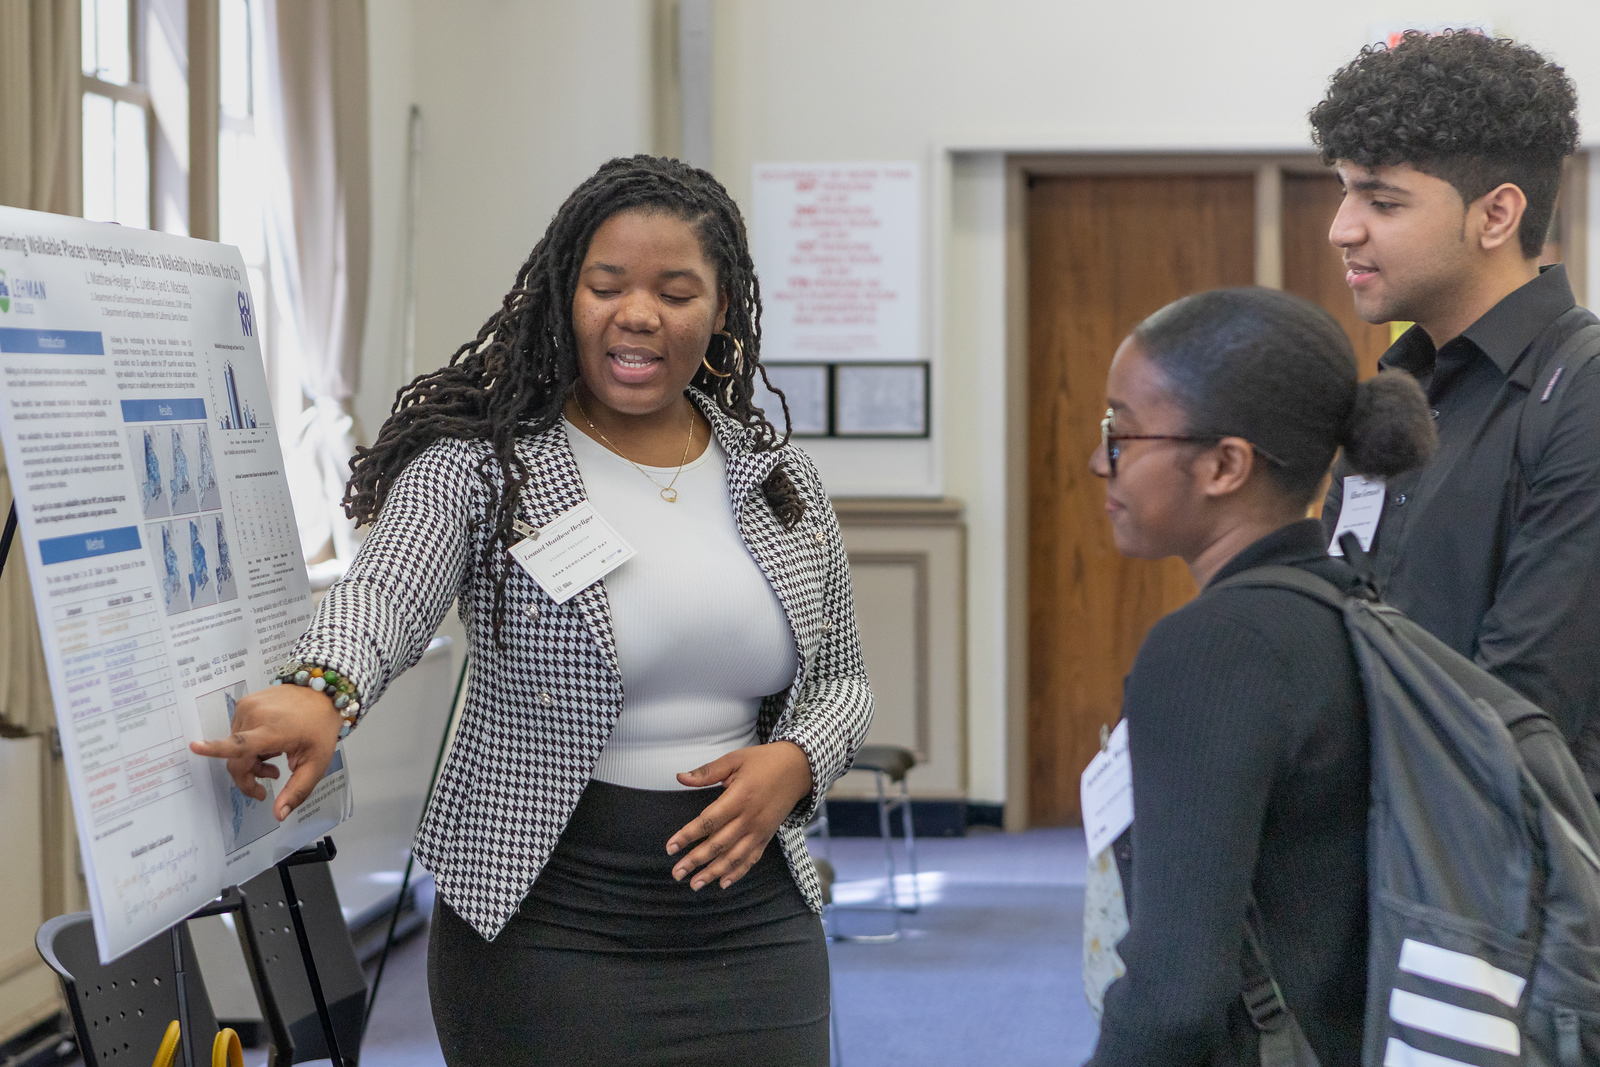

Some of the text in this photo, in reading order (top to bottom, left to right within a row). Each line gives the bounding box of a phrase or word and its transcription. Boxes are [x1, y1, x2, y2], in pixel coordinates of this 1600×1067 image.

[25, 234, 63, 257] Walkable
[61, 238, 88, 260] Places:
[86, 243, 124, 268] Integrating
[121, 247, 151, 268] Wellness
[158, 253, 192, 277] Walkability
[189, 259, 206, 276] Index
[208, 262, 222, 279] New
[219, 263, 233, 281] York
[230, 265, 242, 285] City
[565, 548, 597, 569] SCHOLARSHIP
[598, 541, 608, 549] DAY
